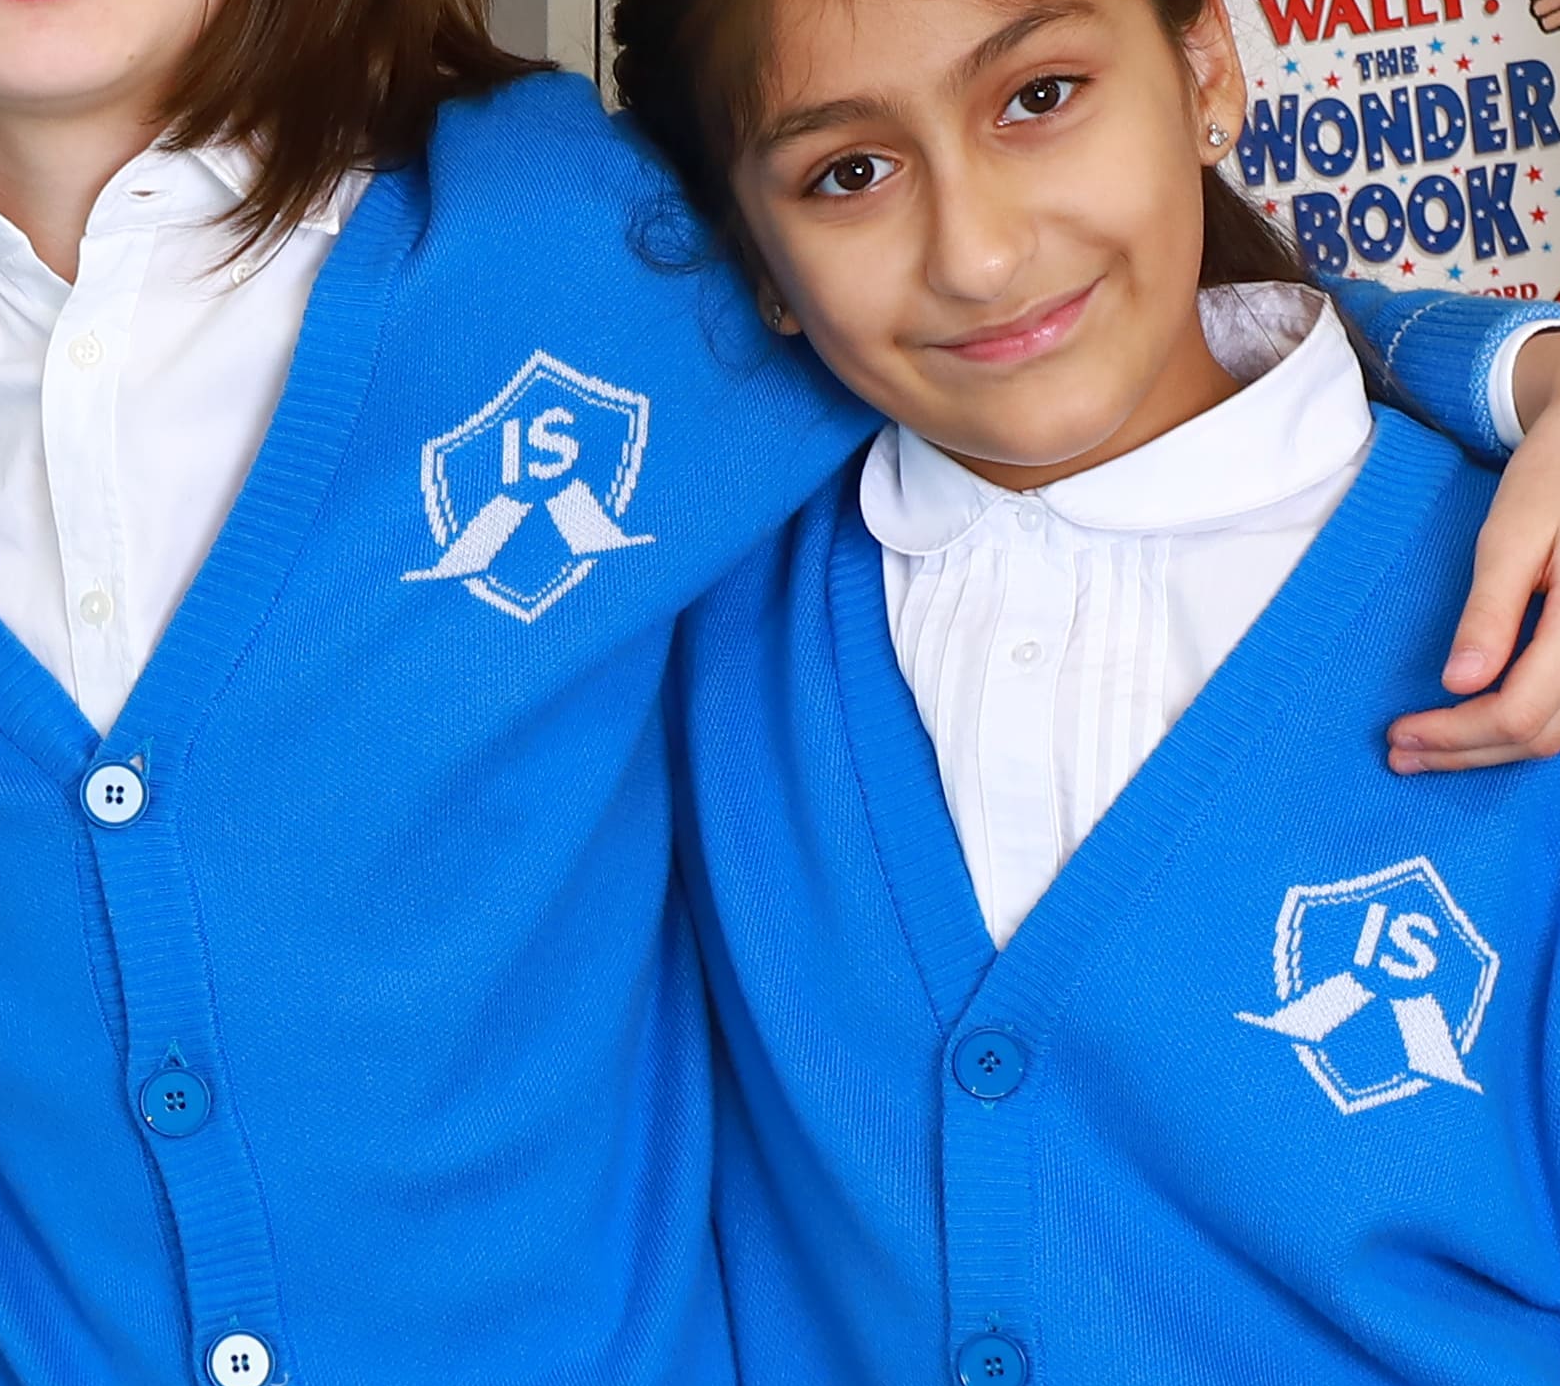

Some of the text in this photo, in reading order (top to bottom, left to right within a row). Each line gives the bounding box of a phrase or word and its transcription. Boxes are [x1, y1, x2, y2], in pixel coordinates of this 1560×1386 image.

[1356, 46, 1420, 81] THE
[1293, 163, 1530, 275] BOOK
[502, 407, 580, 485] IS
[1353, 903, 1440, 980] IS
